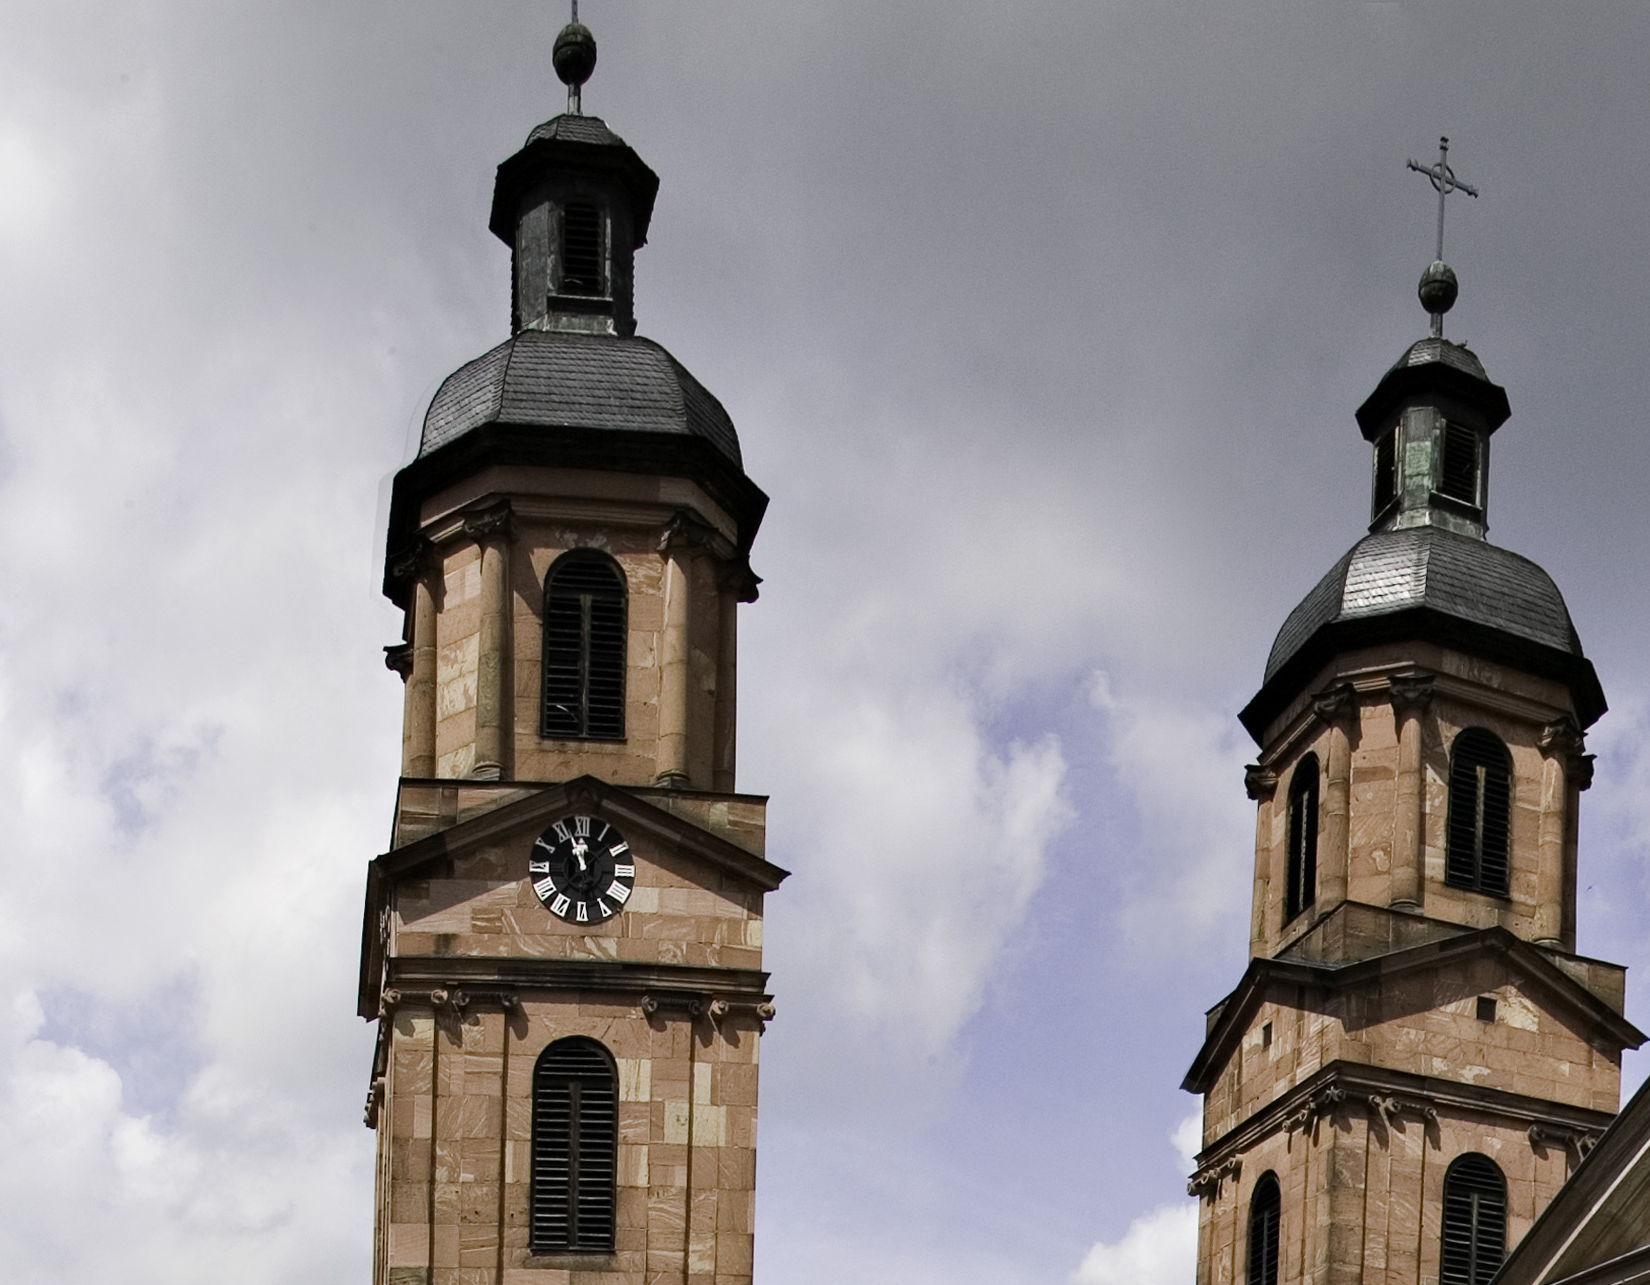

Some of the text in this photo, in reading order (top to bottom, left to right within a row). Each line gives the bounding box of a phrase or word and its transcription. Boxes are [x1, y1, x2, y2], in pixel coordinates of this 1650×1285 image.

[552, 820, 571, 843] XI
[574, 816, 591, 837] XII
[597, 823, 611, 842] I
[535, 837, 556, 854] X
[609, 841, 629, 857] II
[529, 860, 550, 873] IX
[614, 864, 635, 878] III
[533, 876, 557, 901] VIII
[550, 893, 571, 918] VII
[576, 901, 589, 922] VI
[597, 898, 612, 918] V
